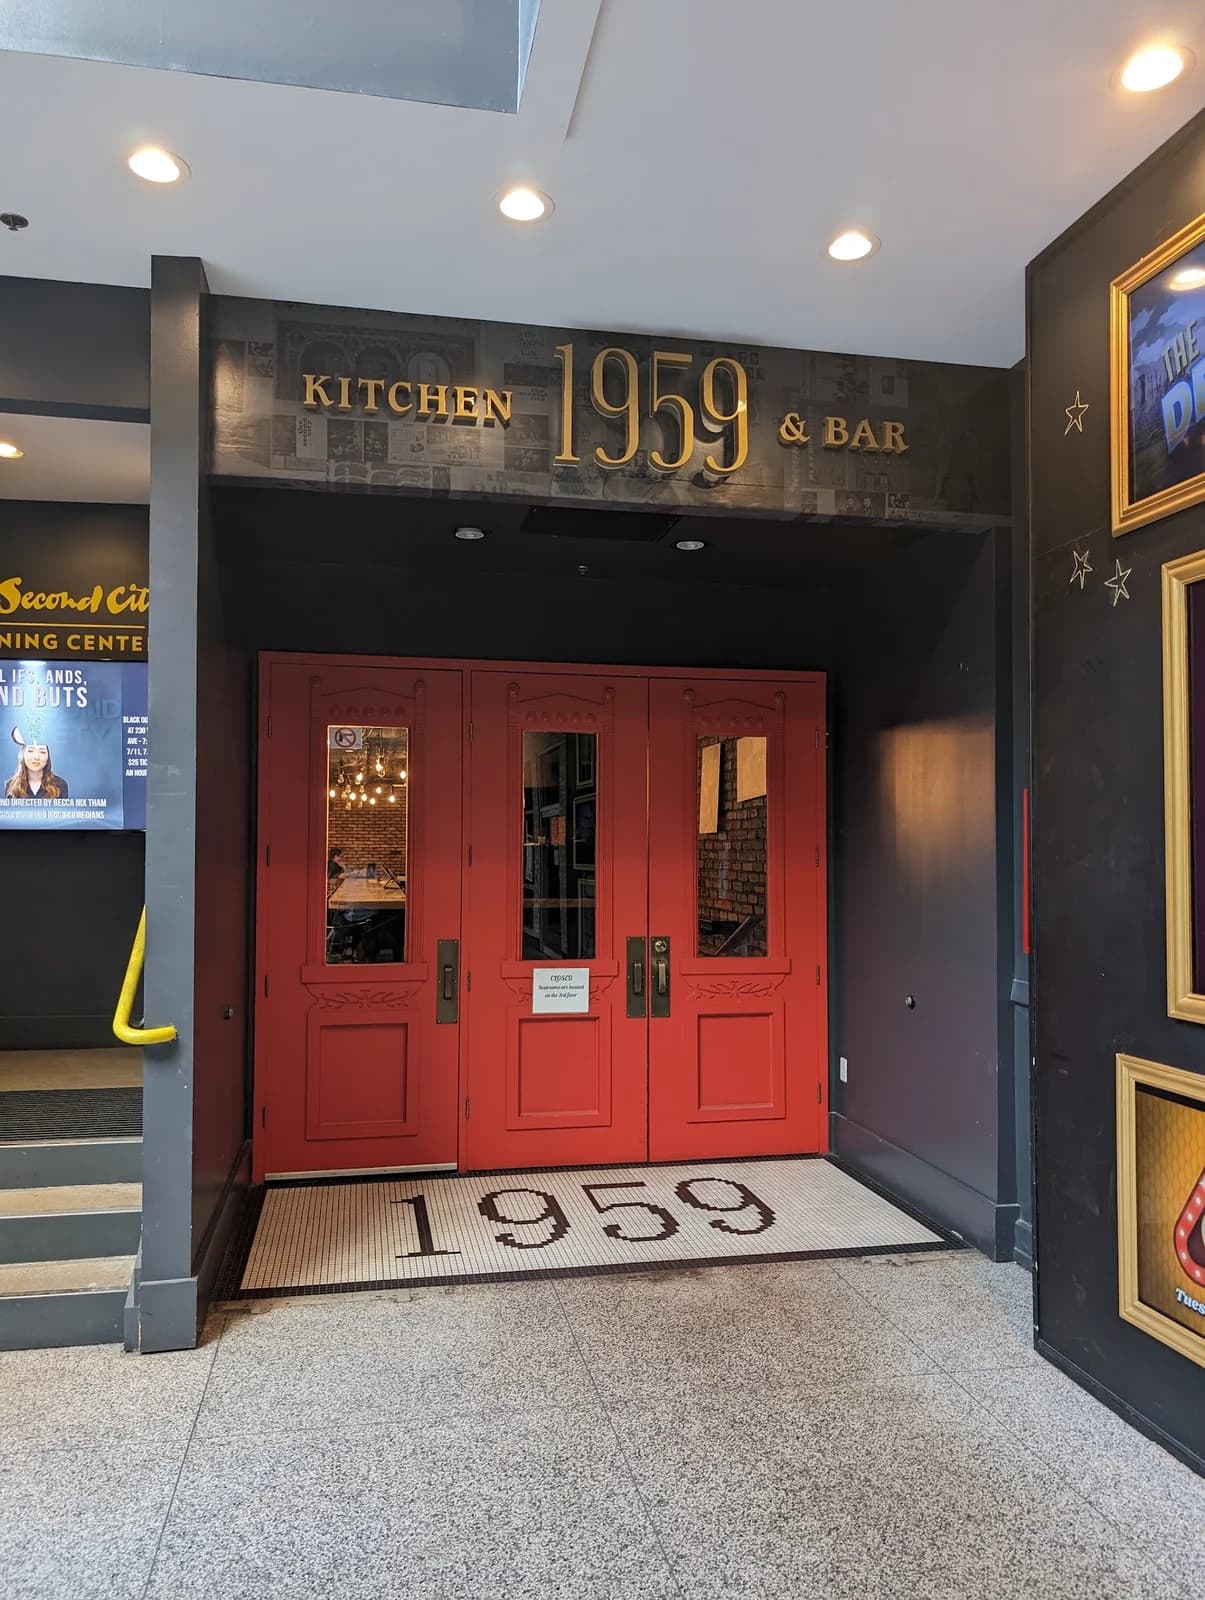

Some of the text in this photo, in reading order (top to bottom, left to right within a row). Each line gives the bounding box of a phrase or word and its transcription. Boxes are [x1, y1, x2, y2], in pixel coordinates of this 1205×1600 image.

[1162, 320, 1199, 382] THE
[303, 373, 513, 422] KITCHEN
[553, 343, 749, 476] 1959
[778, 411, 811, 445] &
[823, 415, 909, 454] BAR
[0, 577, 103, 614] Second
[66, 634, 149, 652] CENTE
[12, 669, 40, 685] IFS,
[46, 669, 87, 686] ANDS,
[34, 686, 88, 708] BUTS
[88, 799, 106, 807] THAM
[390, 1177, 777, 1259] 1959
